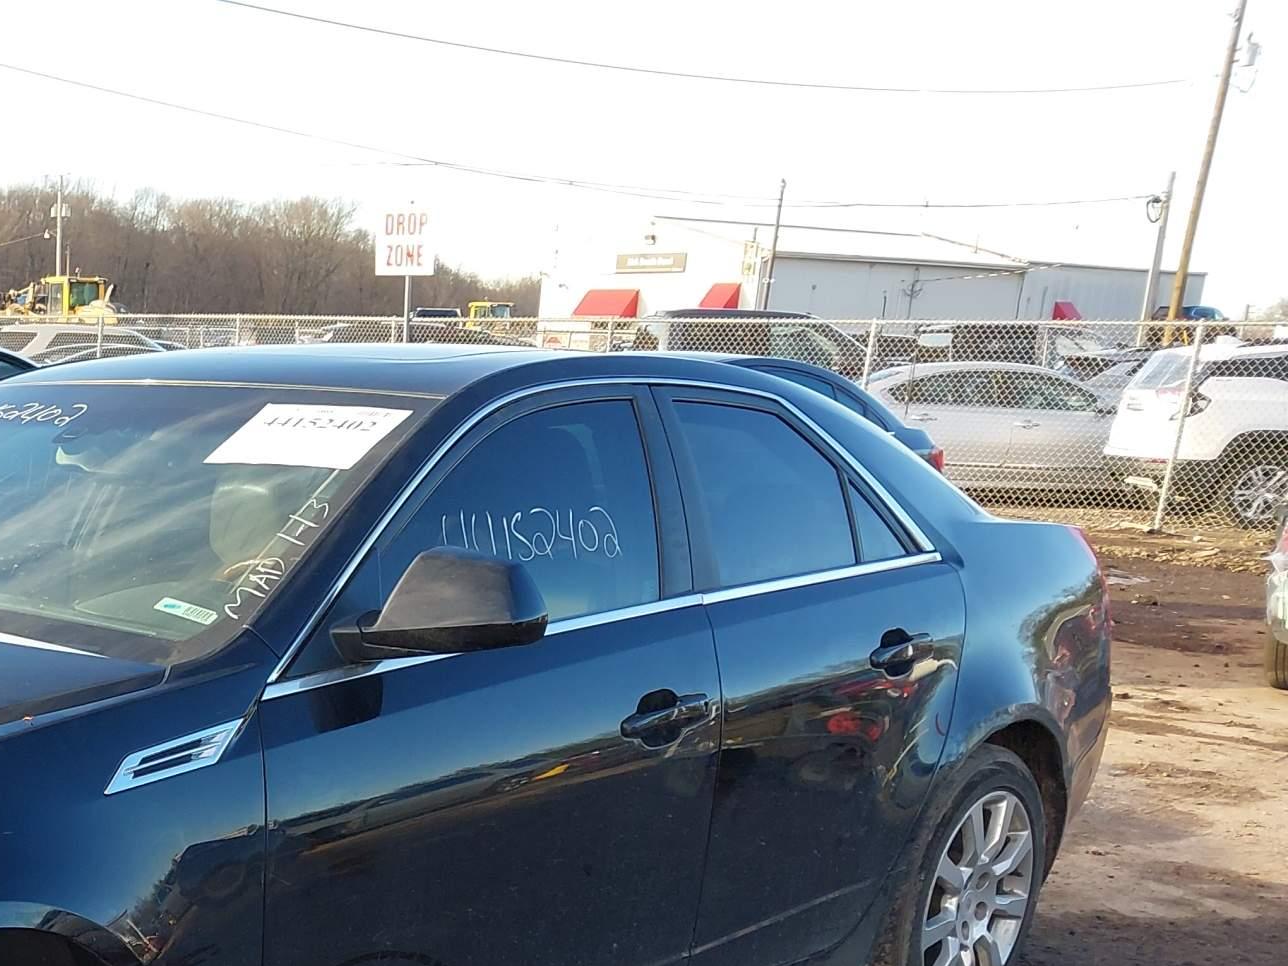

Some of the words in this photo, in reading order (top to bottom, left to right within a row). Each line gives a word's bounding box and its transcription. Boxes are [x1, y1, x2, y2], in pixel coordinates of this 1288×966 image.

[385, 212, 428, 236] DROP
[385, 244, 424, 267] ZONE
[263, 416, 378, 432] 44152402
[223, 556, 285, 620] MAD
